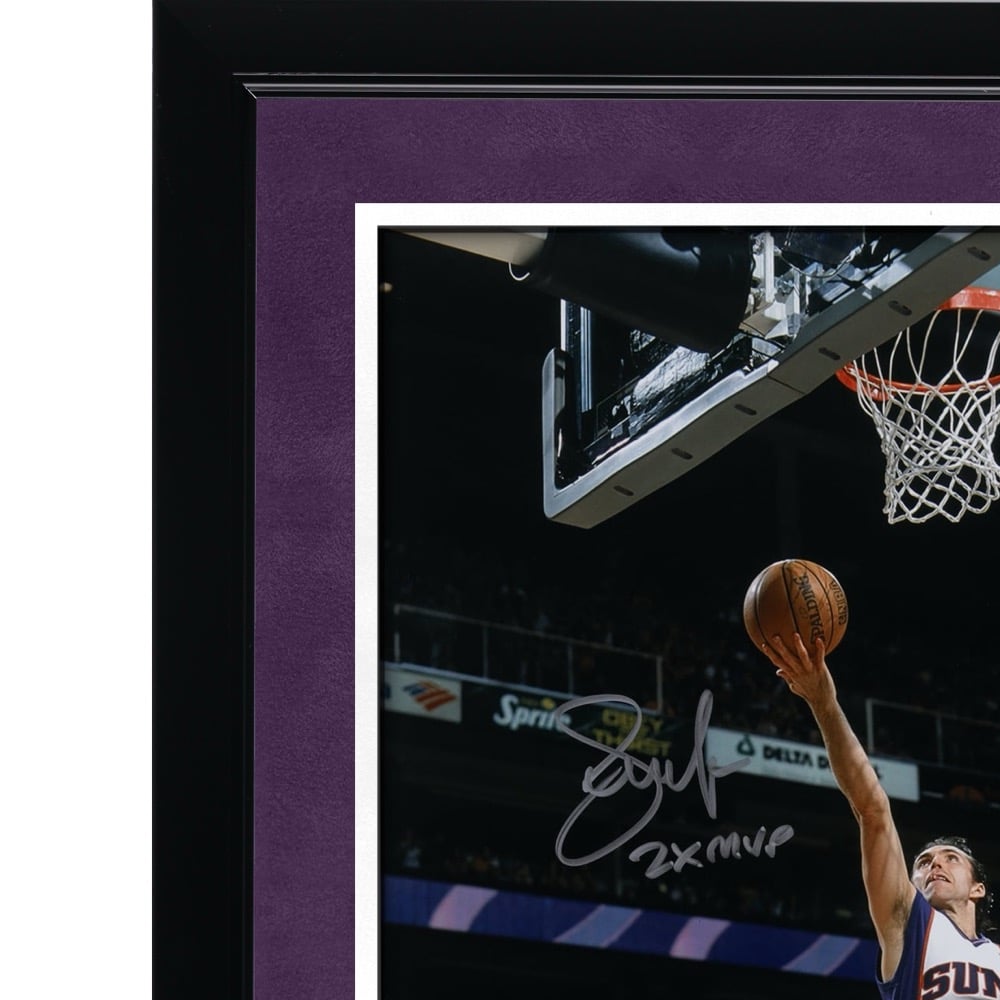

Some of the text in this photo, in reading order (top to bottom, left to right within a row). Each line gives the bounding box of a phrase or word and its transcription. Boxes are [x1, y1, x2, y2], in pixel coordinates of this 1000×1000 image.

[492, 693, 573, 732] Sprite
[591, 727, 672, 757] THRST
[763, 745, 813, 766] DELTA
